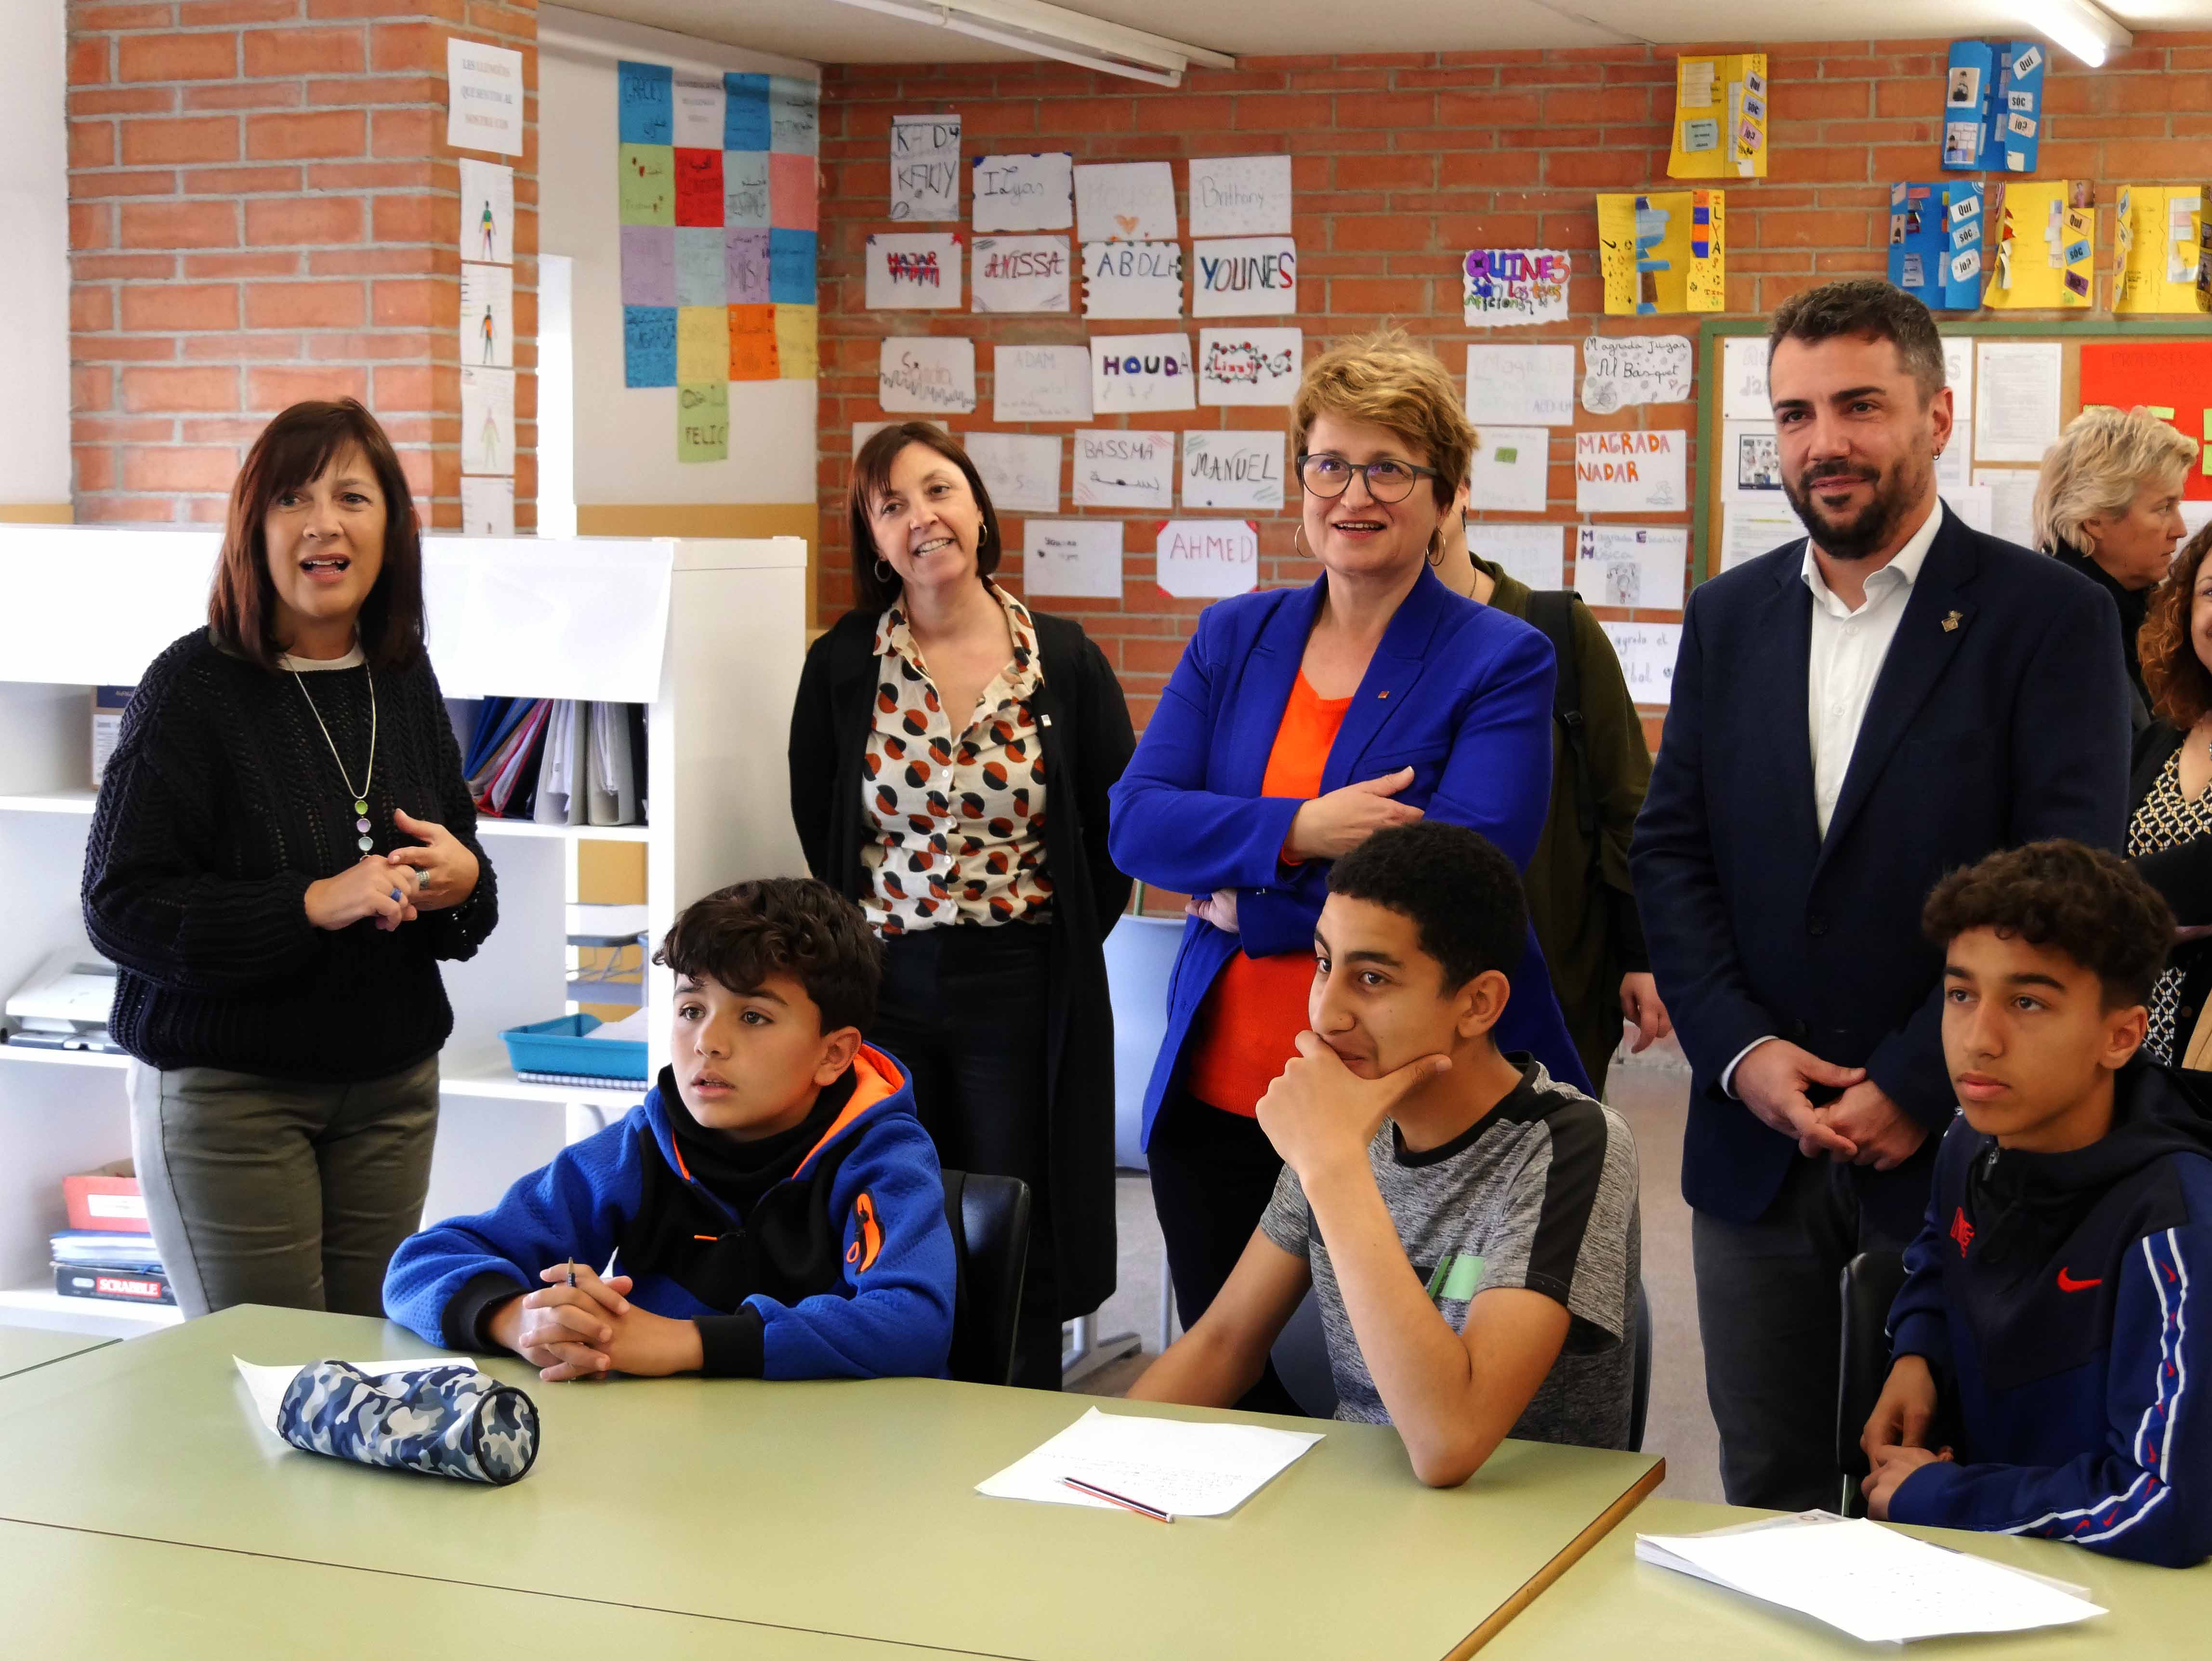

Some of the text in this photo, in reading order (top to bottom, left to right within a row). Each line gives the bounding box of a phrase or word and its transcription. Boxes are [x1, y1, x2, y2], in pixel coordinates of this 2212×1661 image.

[1199, 250, 1294, 292] YOUNES
[1467, 250, 1571, 284] QUINES
[1103, 351, 1191, 376] HOUDA
[1083, 439, 1155, 461] BASSMA
[1191, 451, 1279, 482] MANUEL
[1577, 461, 1640, 485] NADAR
[1170, 532, 1255, 564] AHMED
[99, 1279, 159, 1295] SCRABBLE
